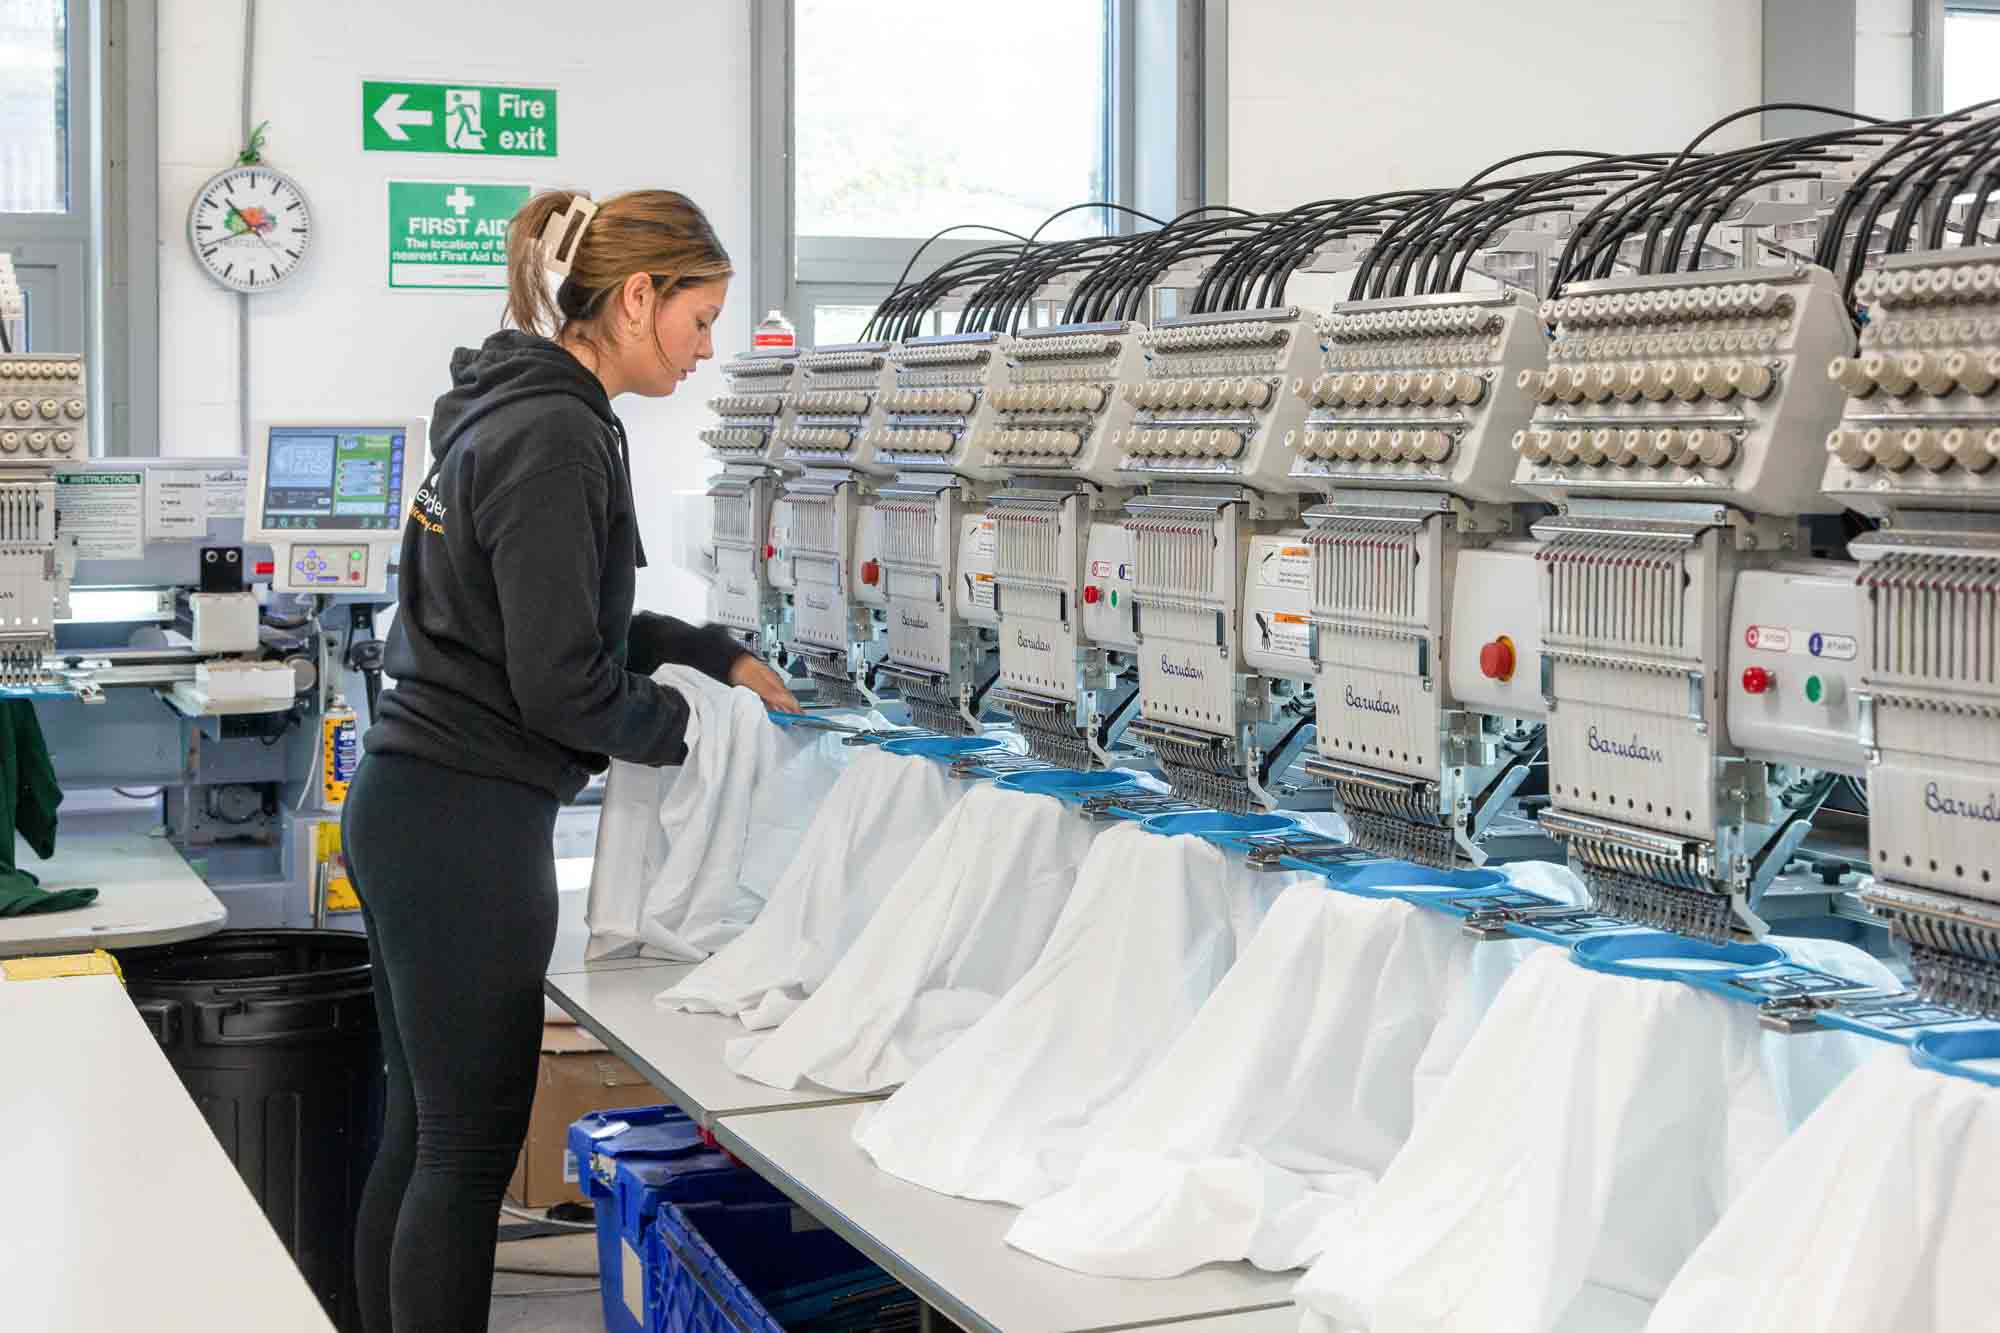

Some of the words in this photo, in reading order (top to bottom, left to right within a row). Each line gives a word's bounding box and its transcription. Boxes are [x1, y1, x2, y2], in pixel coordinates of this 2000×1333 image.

[498, 93, 545, 118] Fire
[499, 127, 546, 150] exit
[408, 217, 470, 236] FIRST
[474, 218, 510, 237] AID
[405, 237, 428, 249] The
[431, 238, 479, 250] location
[481, 239, 494, 250] of
[392, 251, 437, 261] nearest
[440, 250, 467, 261] First
[470, 250, 490, 262] Aid
[1017, 629, 1052, 652] Barudan
[1161, 654, 1204, 681] Barudan
[1345, 685, 1400, 716] Barudan
[1588, 726, 1663, 763] Barudan
[1925, 781, 2000, 822] Barud
